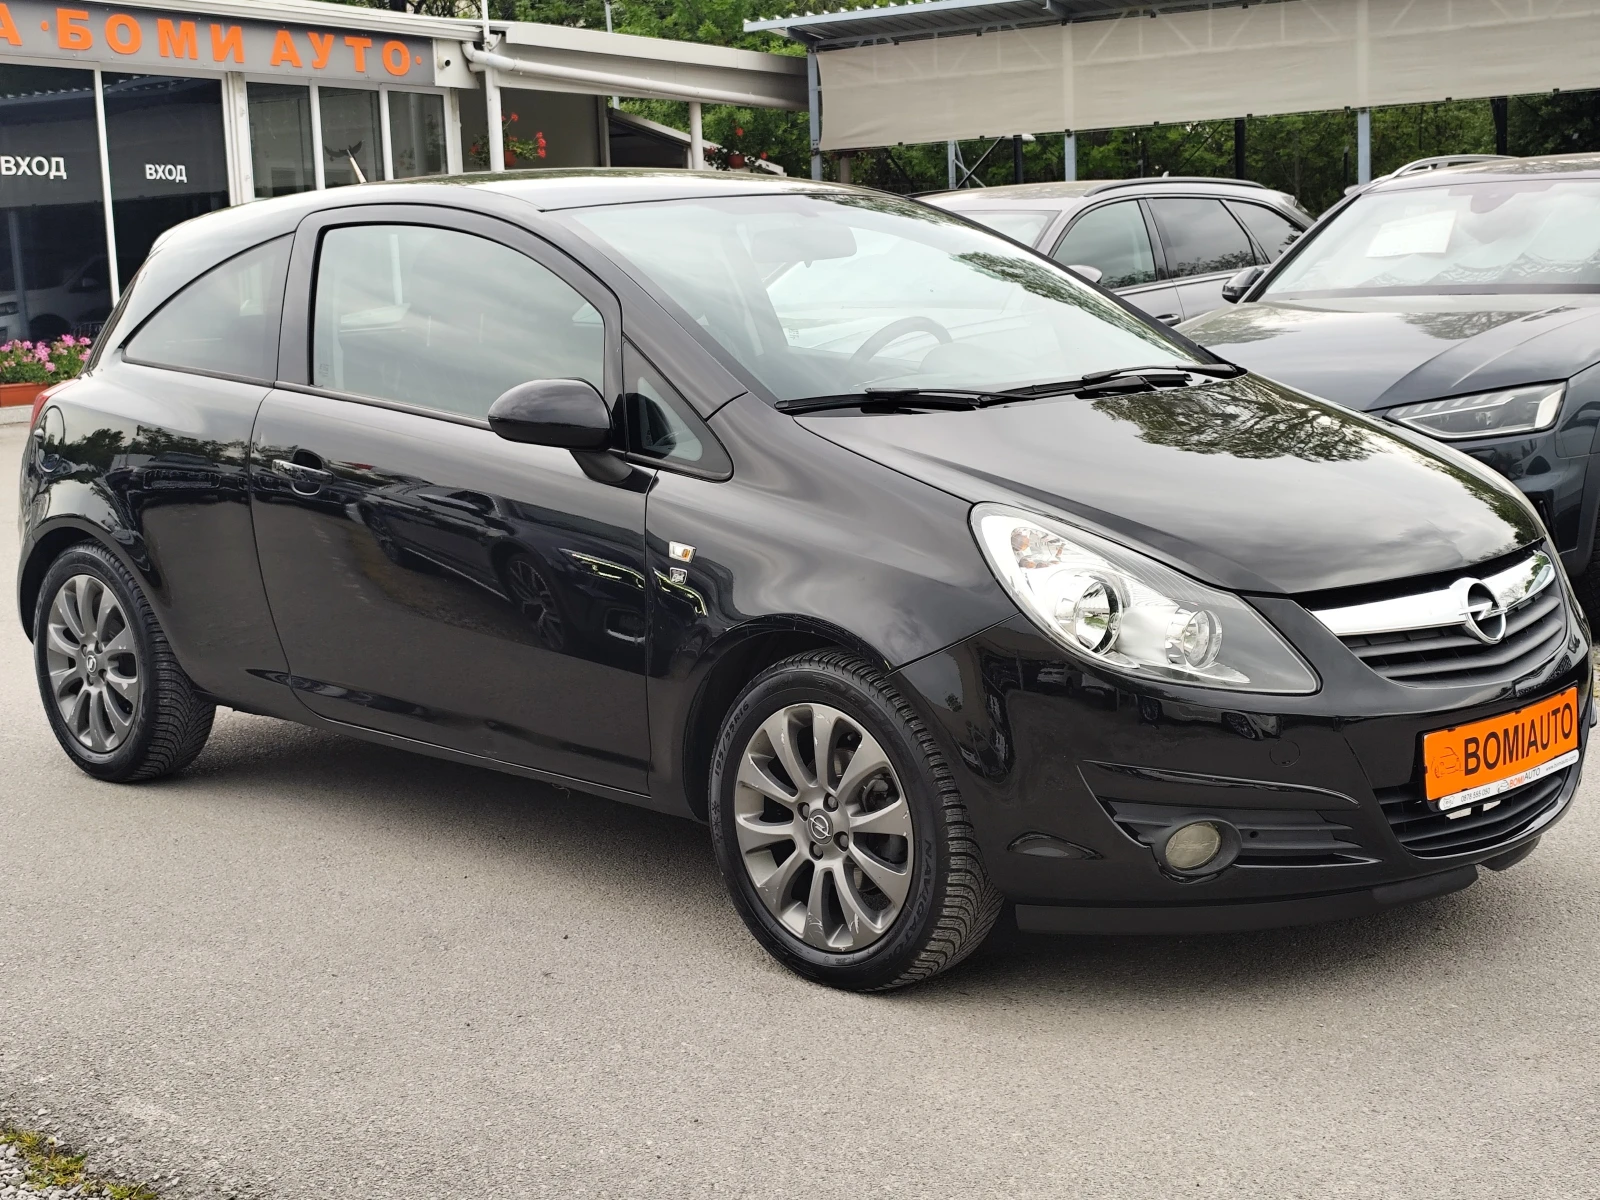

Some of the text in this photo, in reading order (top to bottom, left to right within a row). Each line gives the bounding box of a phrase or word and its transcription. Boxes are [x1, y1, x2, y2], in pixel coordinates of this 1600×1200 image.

[1, 156, 68, 181] ВХОД
[145, 163, 188, 184] ВХОД
[1464, 702, 1574, 777] BOMIAUTO
